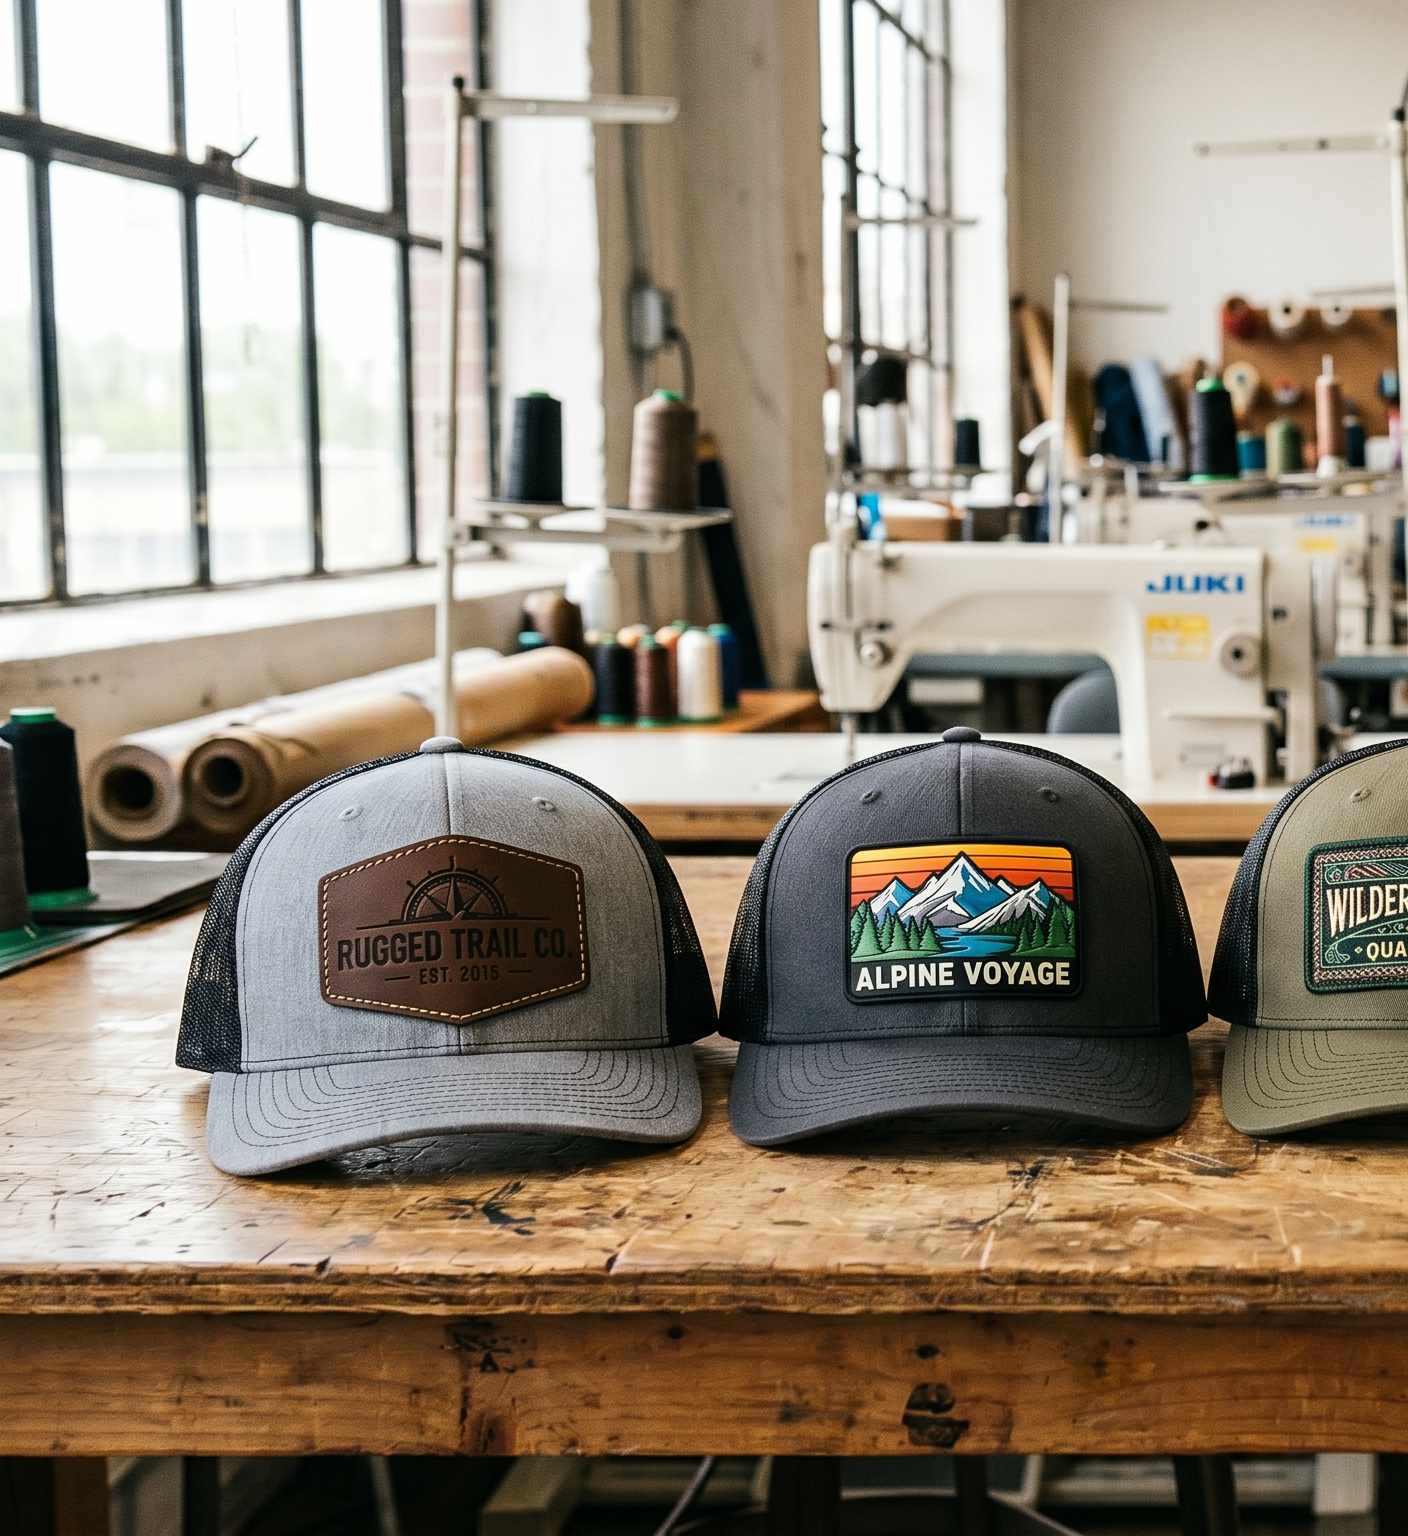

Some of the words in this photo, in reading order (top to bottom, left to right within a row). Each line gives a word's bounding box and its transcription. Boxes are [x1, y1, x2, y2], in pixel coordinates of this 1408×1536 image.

[1146, 575, 1245, 593] JUKI
[337, 930, 442, 971] RUGGED
[452, 927, 526, 959] TRAIL
[533, 926, 573, 959] CO.
[419, 966, 453, 985] EST.
[855, 962, 954, 992] ALPINE
[964, 961, 1070, 986] VOYAGE
